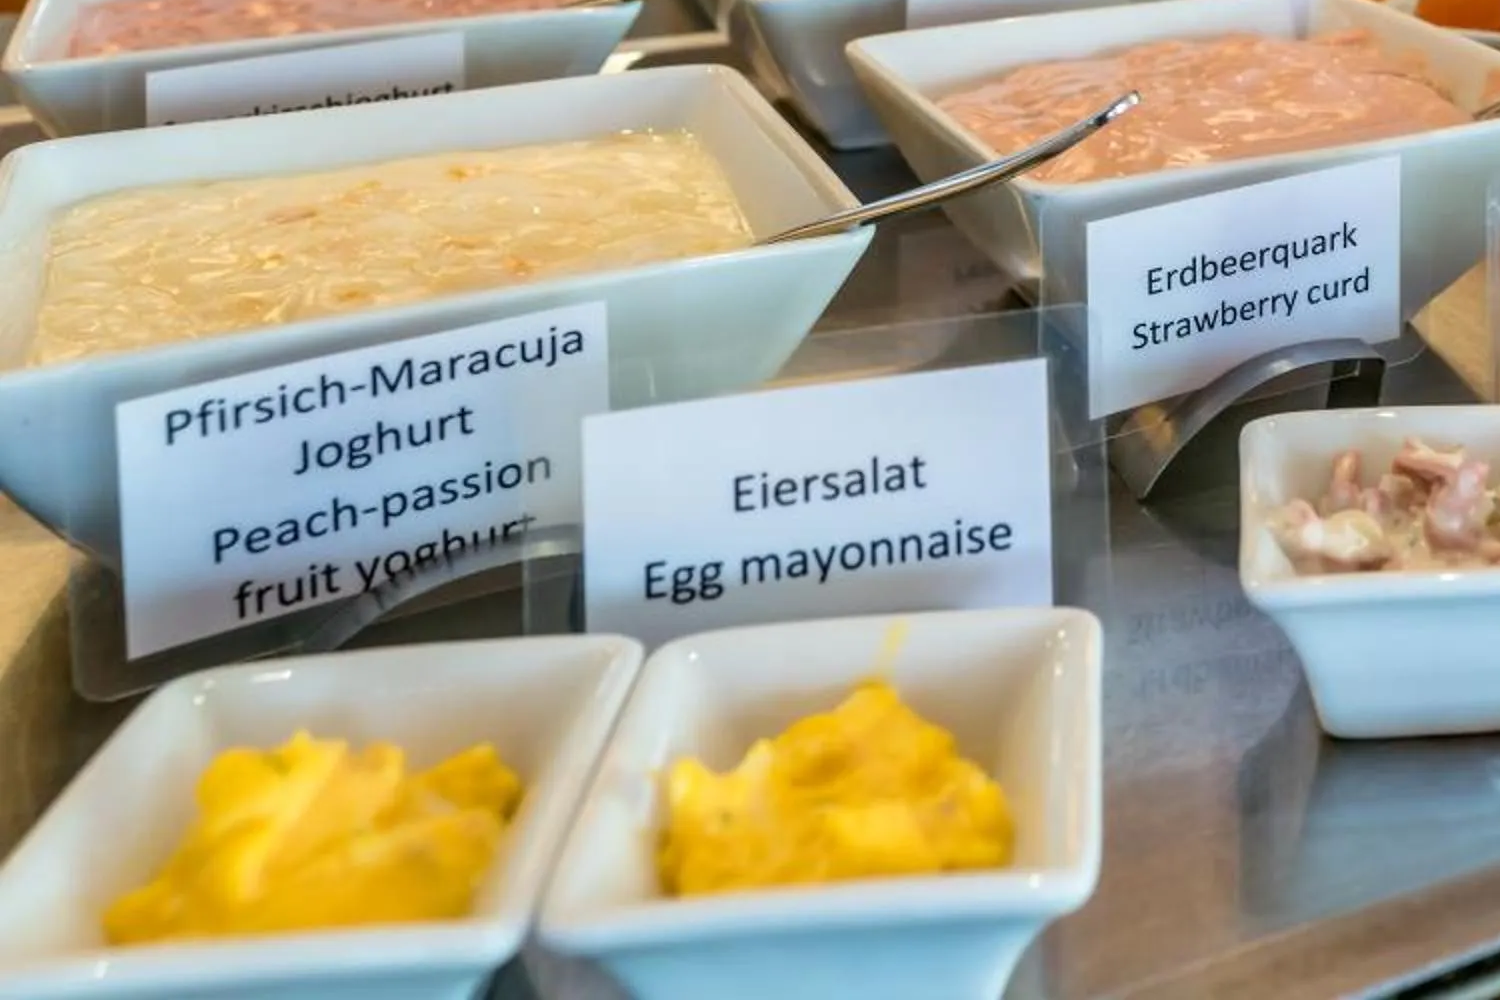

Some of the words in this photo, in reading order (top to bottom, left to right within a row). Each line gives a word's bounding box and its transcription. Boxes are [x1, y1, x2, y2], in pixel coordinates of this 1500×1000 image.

[1147, 221, 1359, 296] Erdbeerquark
[1131, 288, 1299, 351] Strawberry
[1306, 266, 1371, 306] curd
[165, 326, 585, 447] Pfirsich-Maracuja
[292, 405, 475, 476] Joghurt
[212, 454, 552, 564] Peach-passion
[732, 455, 928, 513] Eiersalat
[233, 563, 342, 619] fruit
[643, 558, 726, 604] Egg
[740, 519, 1014, 584] mayonnaise
